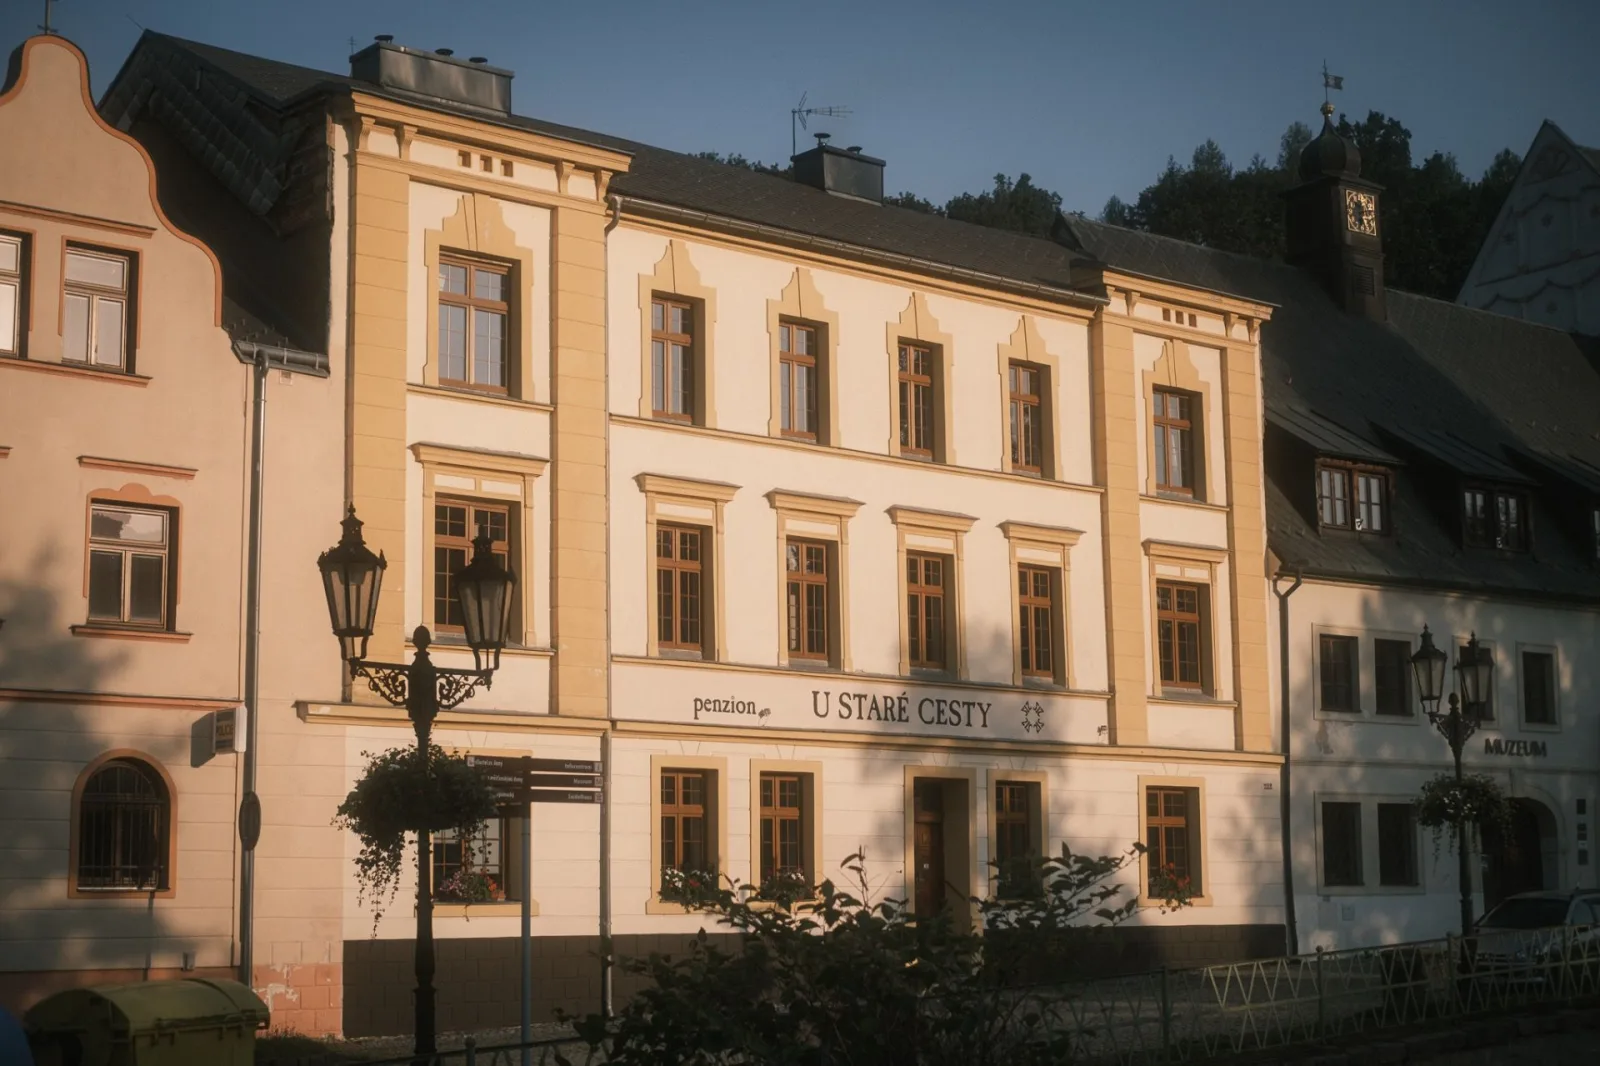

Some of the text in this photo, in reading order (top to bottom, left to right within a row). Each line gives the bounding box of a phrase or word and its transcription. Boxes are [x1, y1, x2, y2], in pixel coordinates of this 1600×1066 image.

[693, 695, 757, 720] penzion
[811, 690, 993, 728] U STARÉ CESTY
[1484, 738, 1547, 757] MUZEUM
